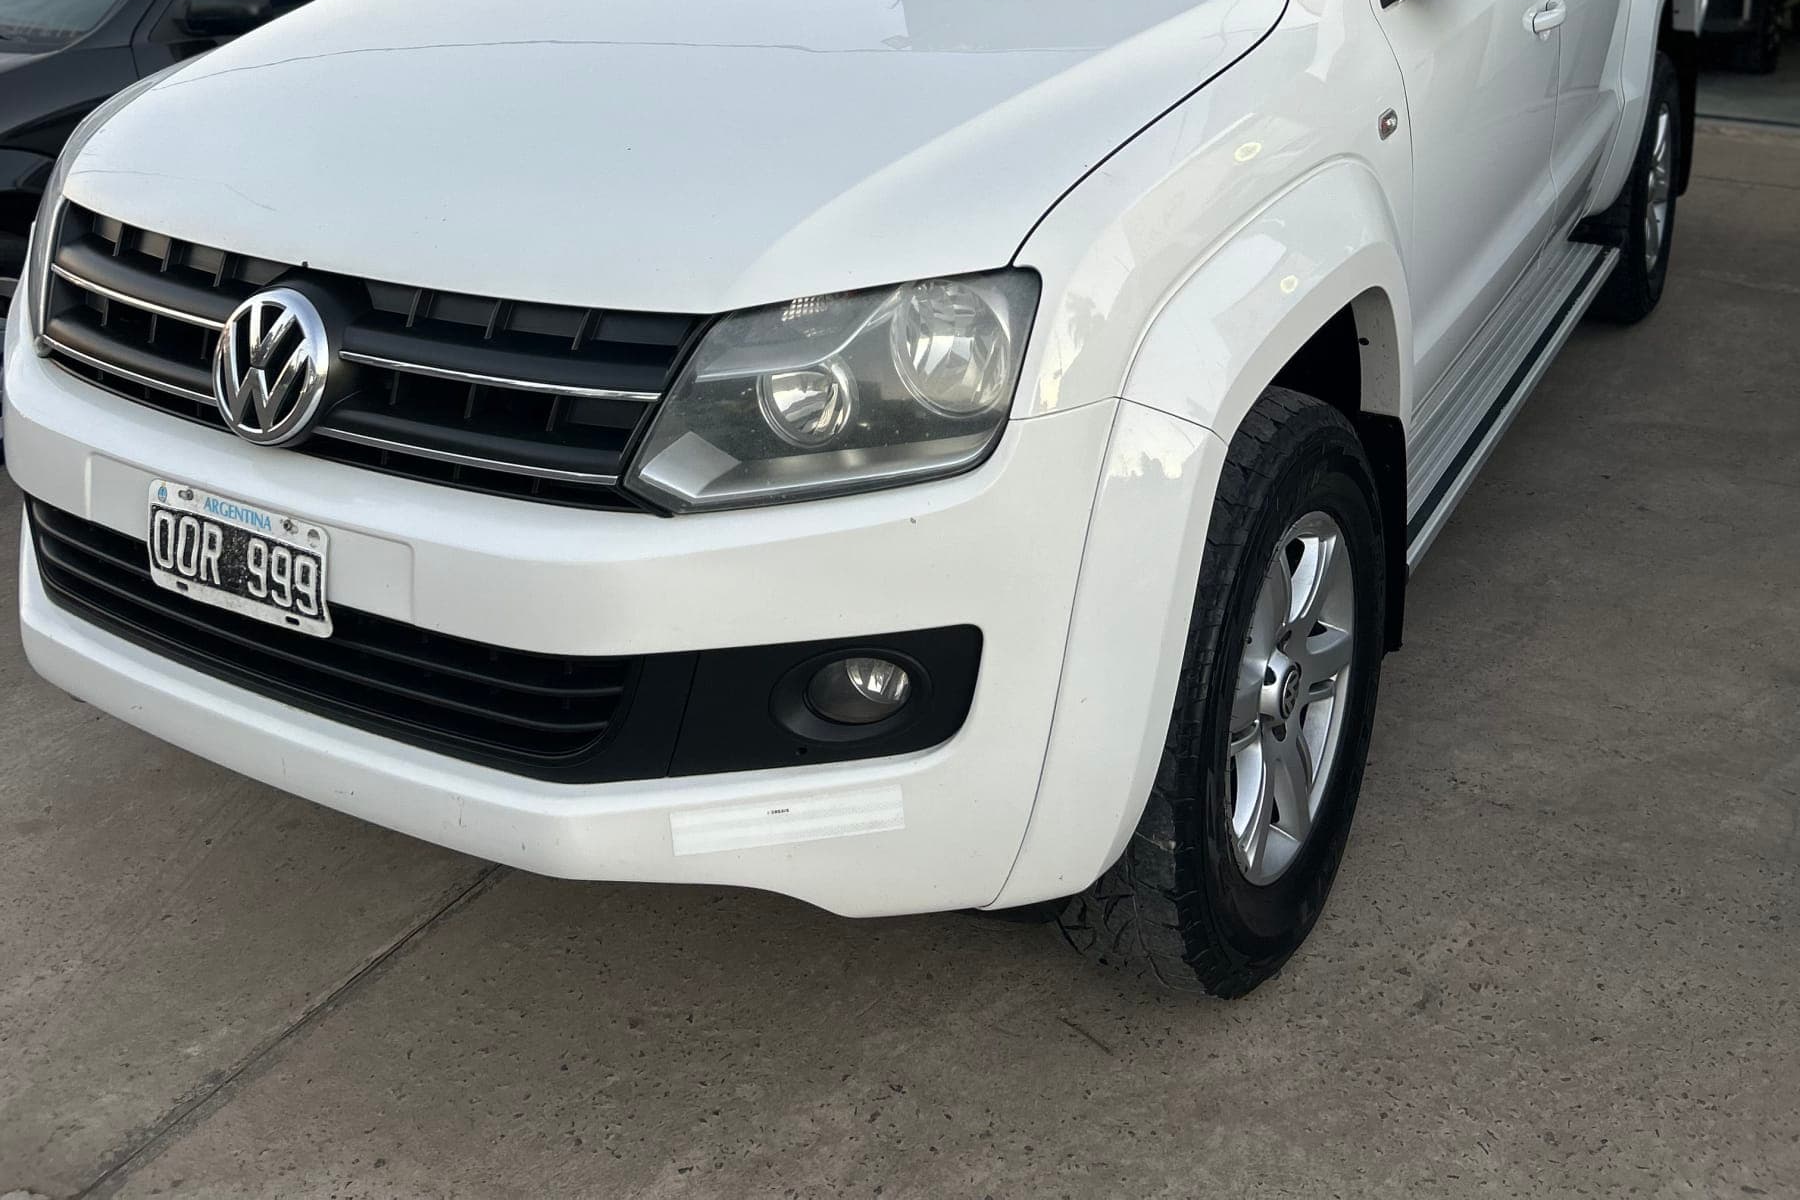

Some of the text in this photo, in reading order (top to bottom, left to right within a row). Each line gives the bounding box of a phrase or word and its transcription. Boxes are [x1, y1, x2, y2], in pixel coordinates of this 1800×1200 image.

[203, 496, 272, 532] ARGENTINA
[154, 509, 319, 616] OOR 999
